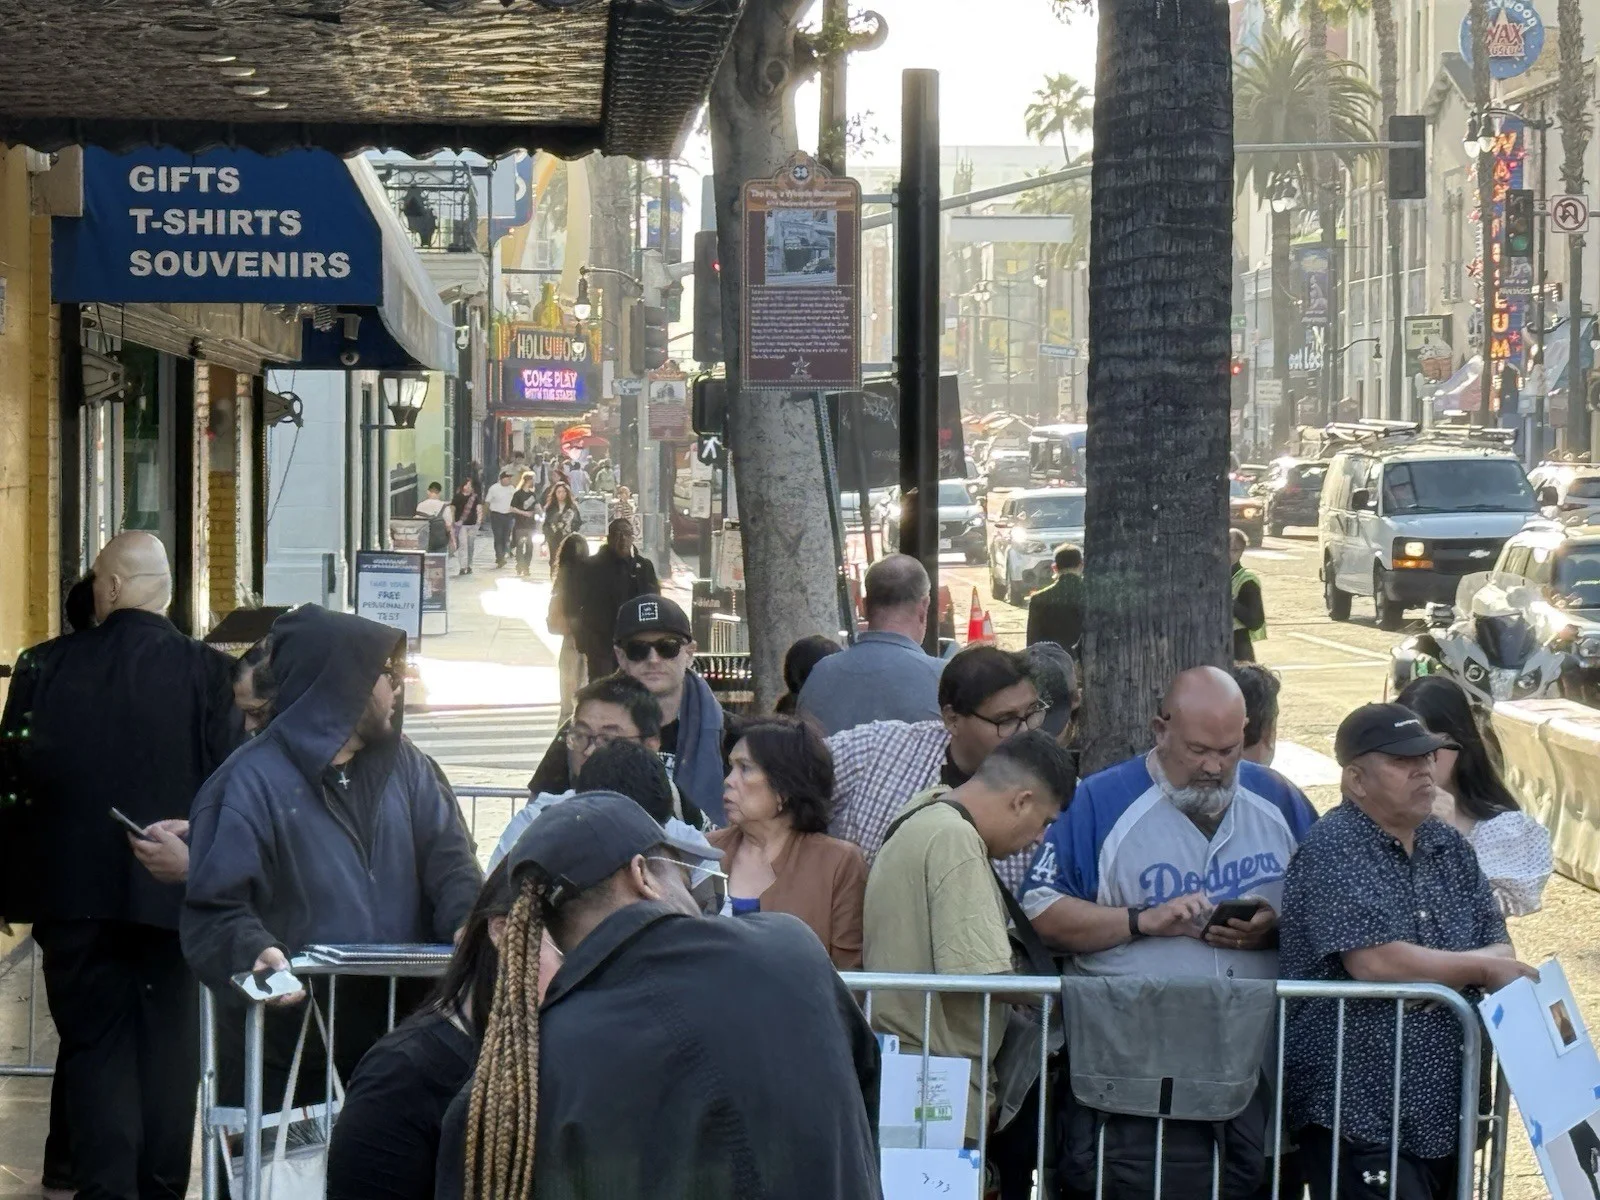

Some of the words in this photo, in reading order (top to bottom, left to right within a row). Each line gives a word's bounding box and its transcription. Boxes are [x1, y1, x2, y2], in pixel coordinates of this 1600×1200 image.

[129, 165, 240, 194] GIFTS
[129, 208, 302, 237] T-SHIRTS
[129, 250, 351, 279] SOUVENIRS
[523, 370, 553, 388] COME
[555, 371, 577, 389] PLAY
[377, 590, 401, 601] FREE
[377, 612, 400, 621] TEST
[1139, 852, 1284, 906] Dodgers
